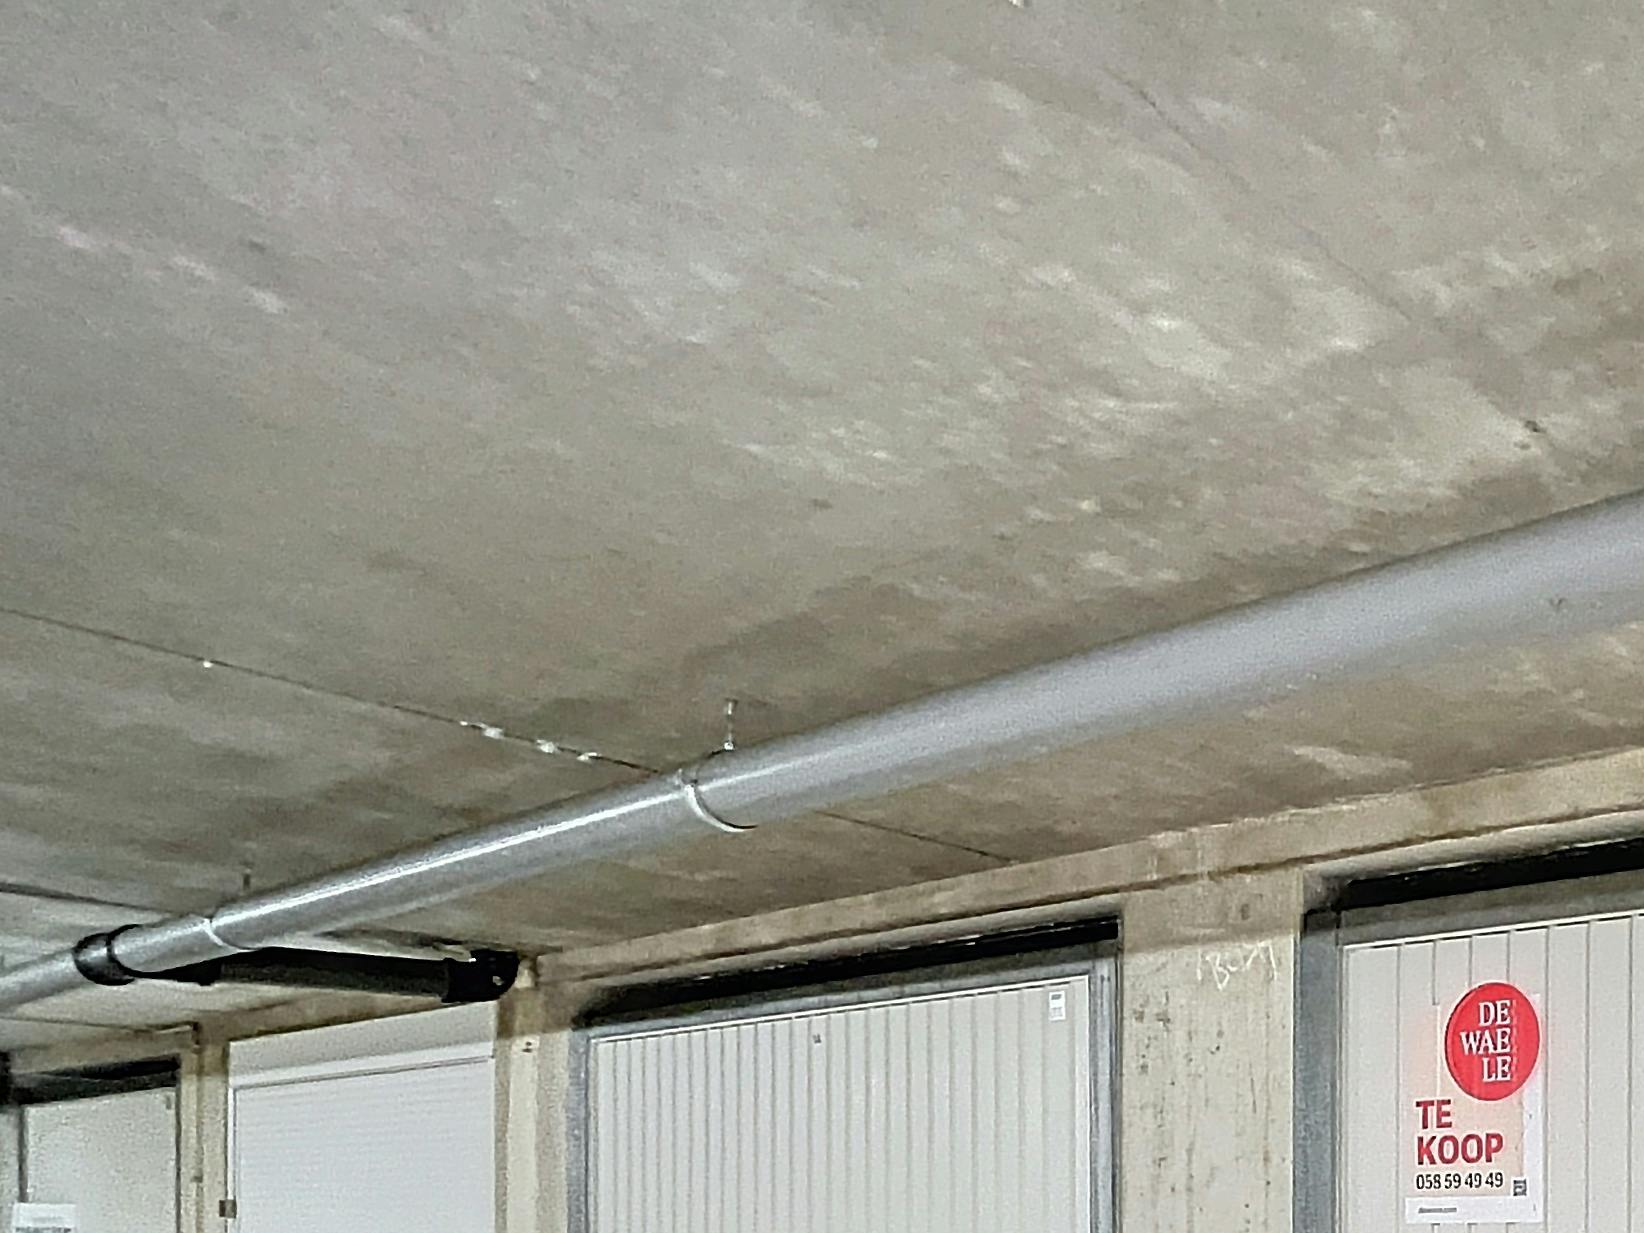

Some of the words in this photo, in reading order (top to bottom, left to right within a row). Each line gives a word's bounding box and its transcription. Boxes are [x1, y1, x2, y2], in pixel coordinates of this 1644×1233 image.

[1479, 1000, 1511, 1027] DE
[1460, 1028, 1511, 1055] WAE
[1482, 1056, 1511, 1082] LE
[1416, 1099, 1453, 1129] TE
[1417, 1133, 1504, 1165] KOOP
[1416, 1174, 1441, 1190] 058
[1444, 1173, 1461, 1189] 59
[1464, 1172, 1482, 1189] 49
[1485, 1172, 1503, 1188] 49
